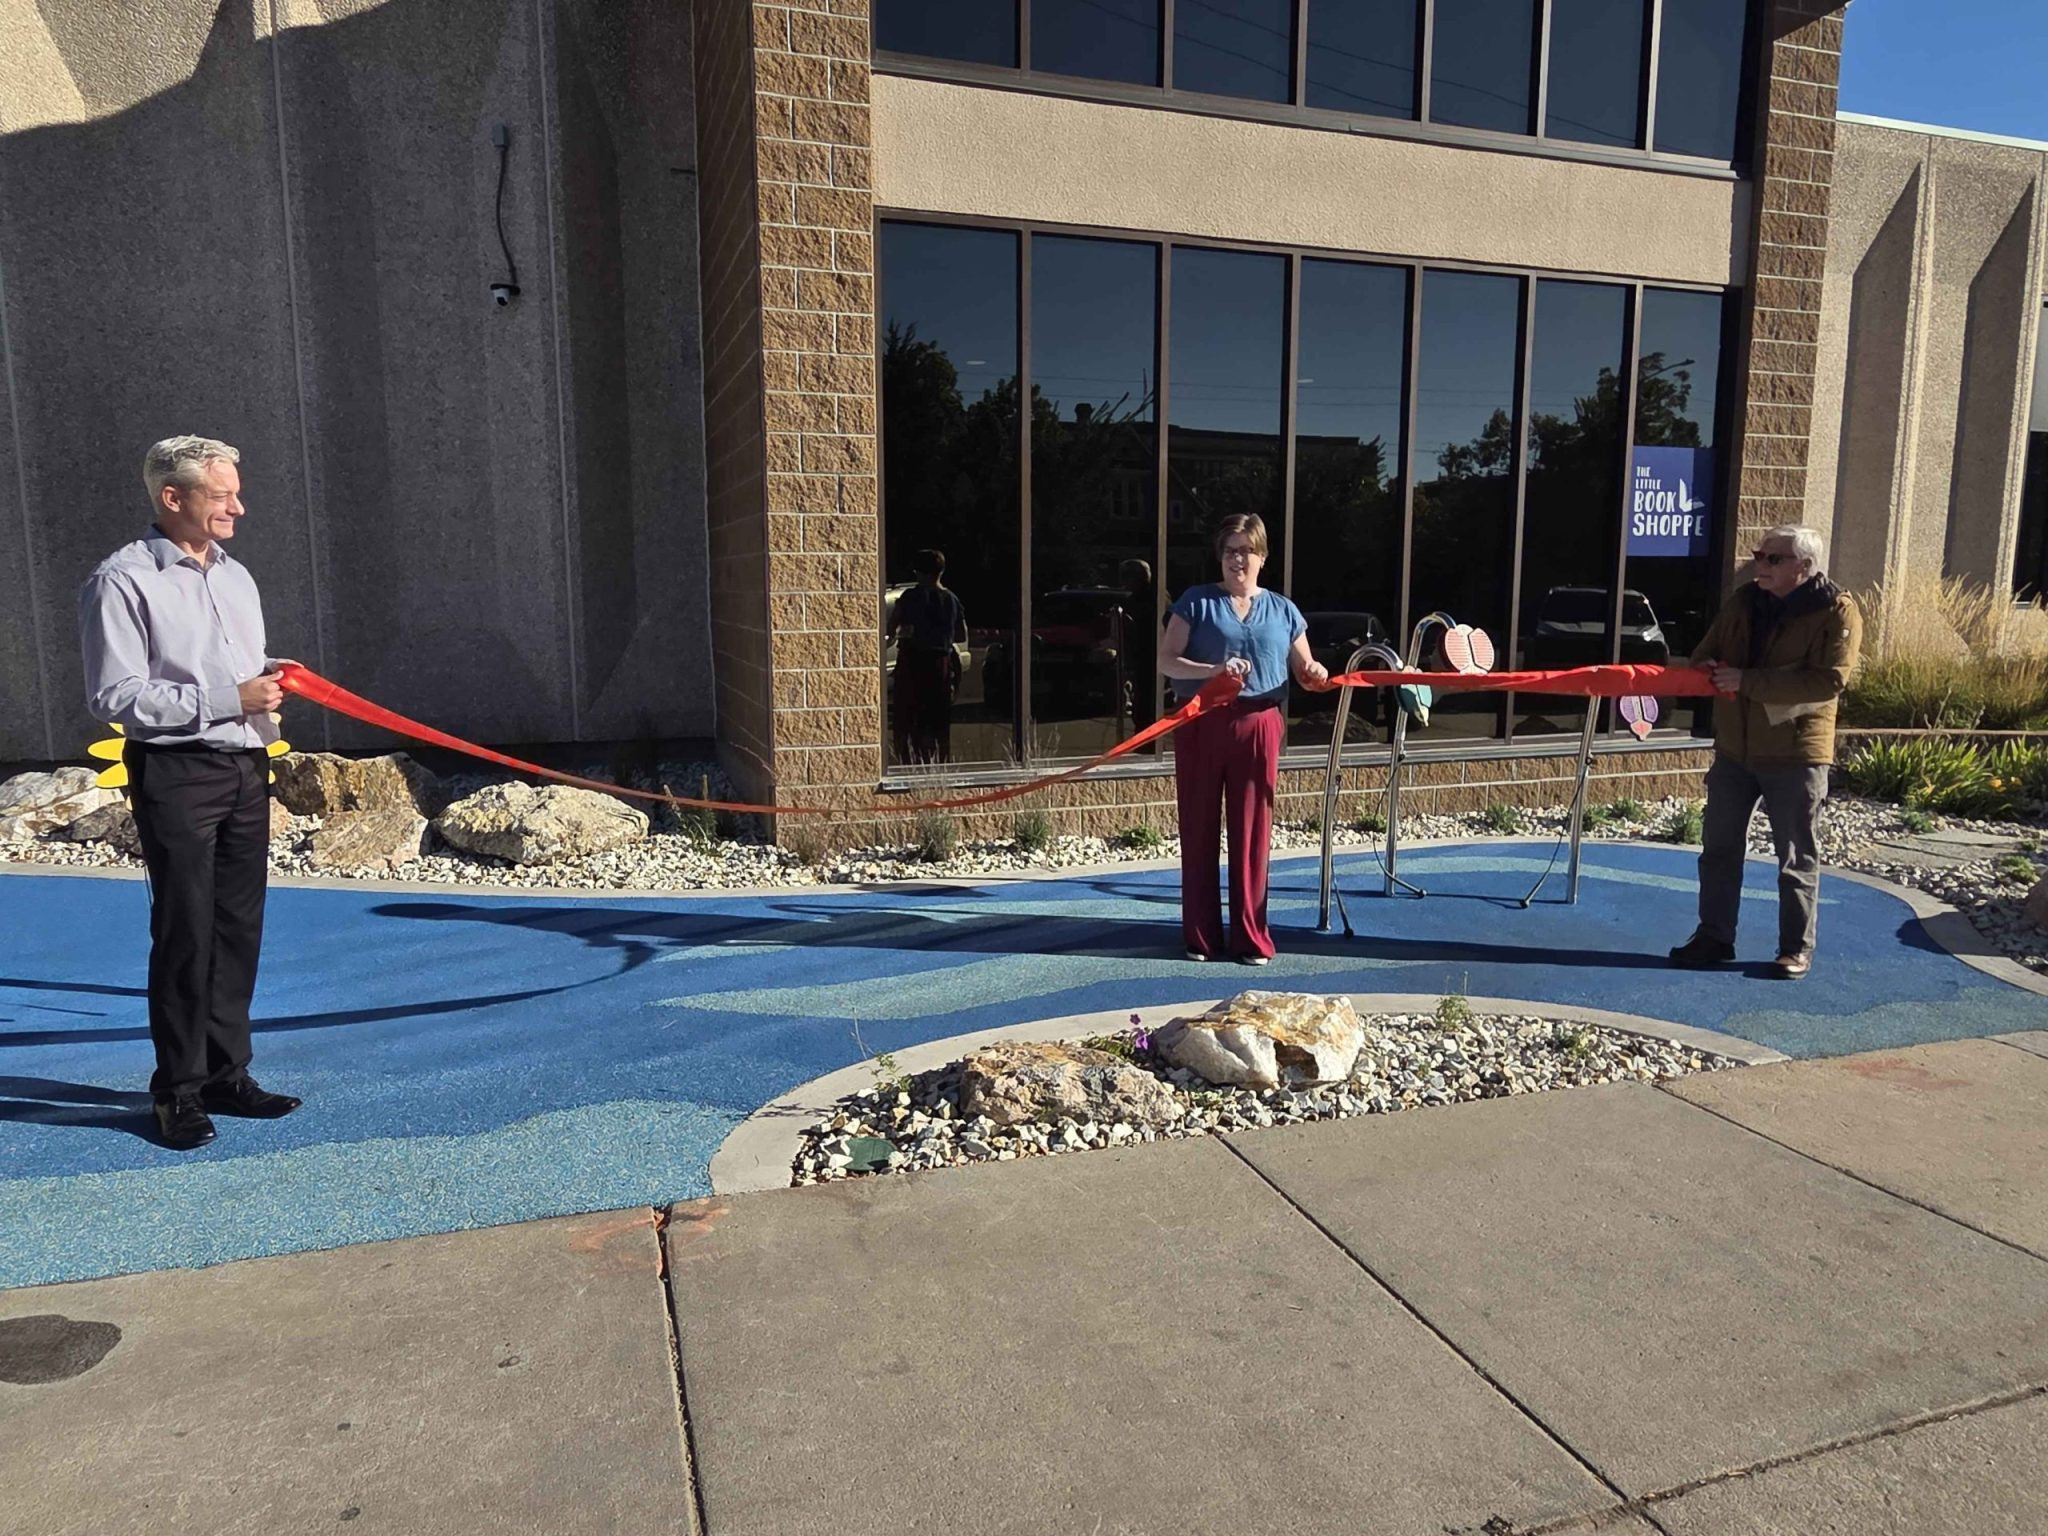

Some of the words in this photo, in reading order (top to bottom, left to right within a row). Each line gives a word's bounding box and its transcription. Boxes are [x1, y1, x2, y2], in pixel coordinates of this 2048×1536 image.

[1636, 466, 1650, 477] THE
[1635, 479, 1661, 490] LITTLE
[1634, 491, 1676, 512] BOOK
[1632, 513, 1704, 536] SHOPPE
